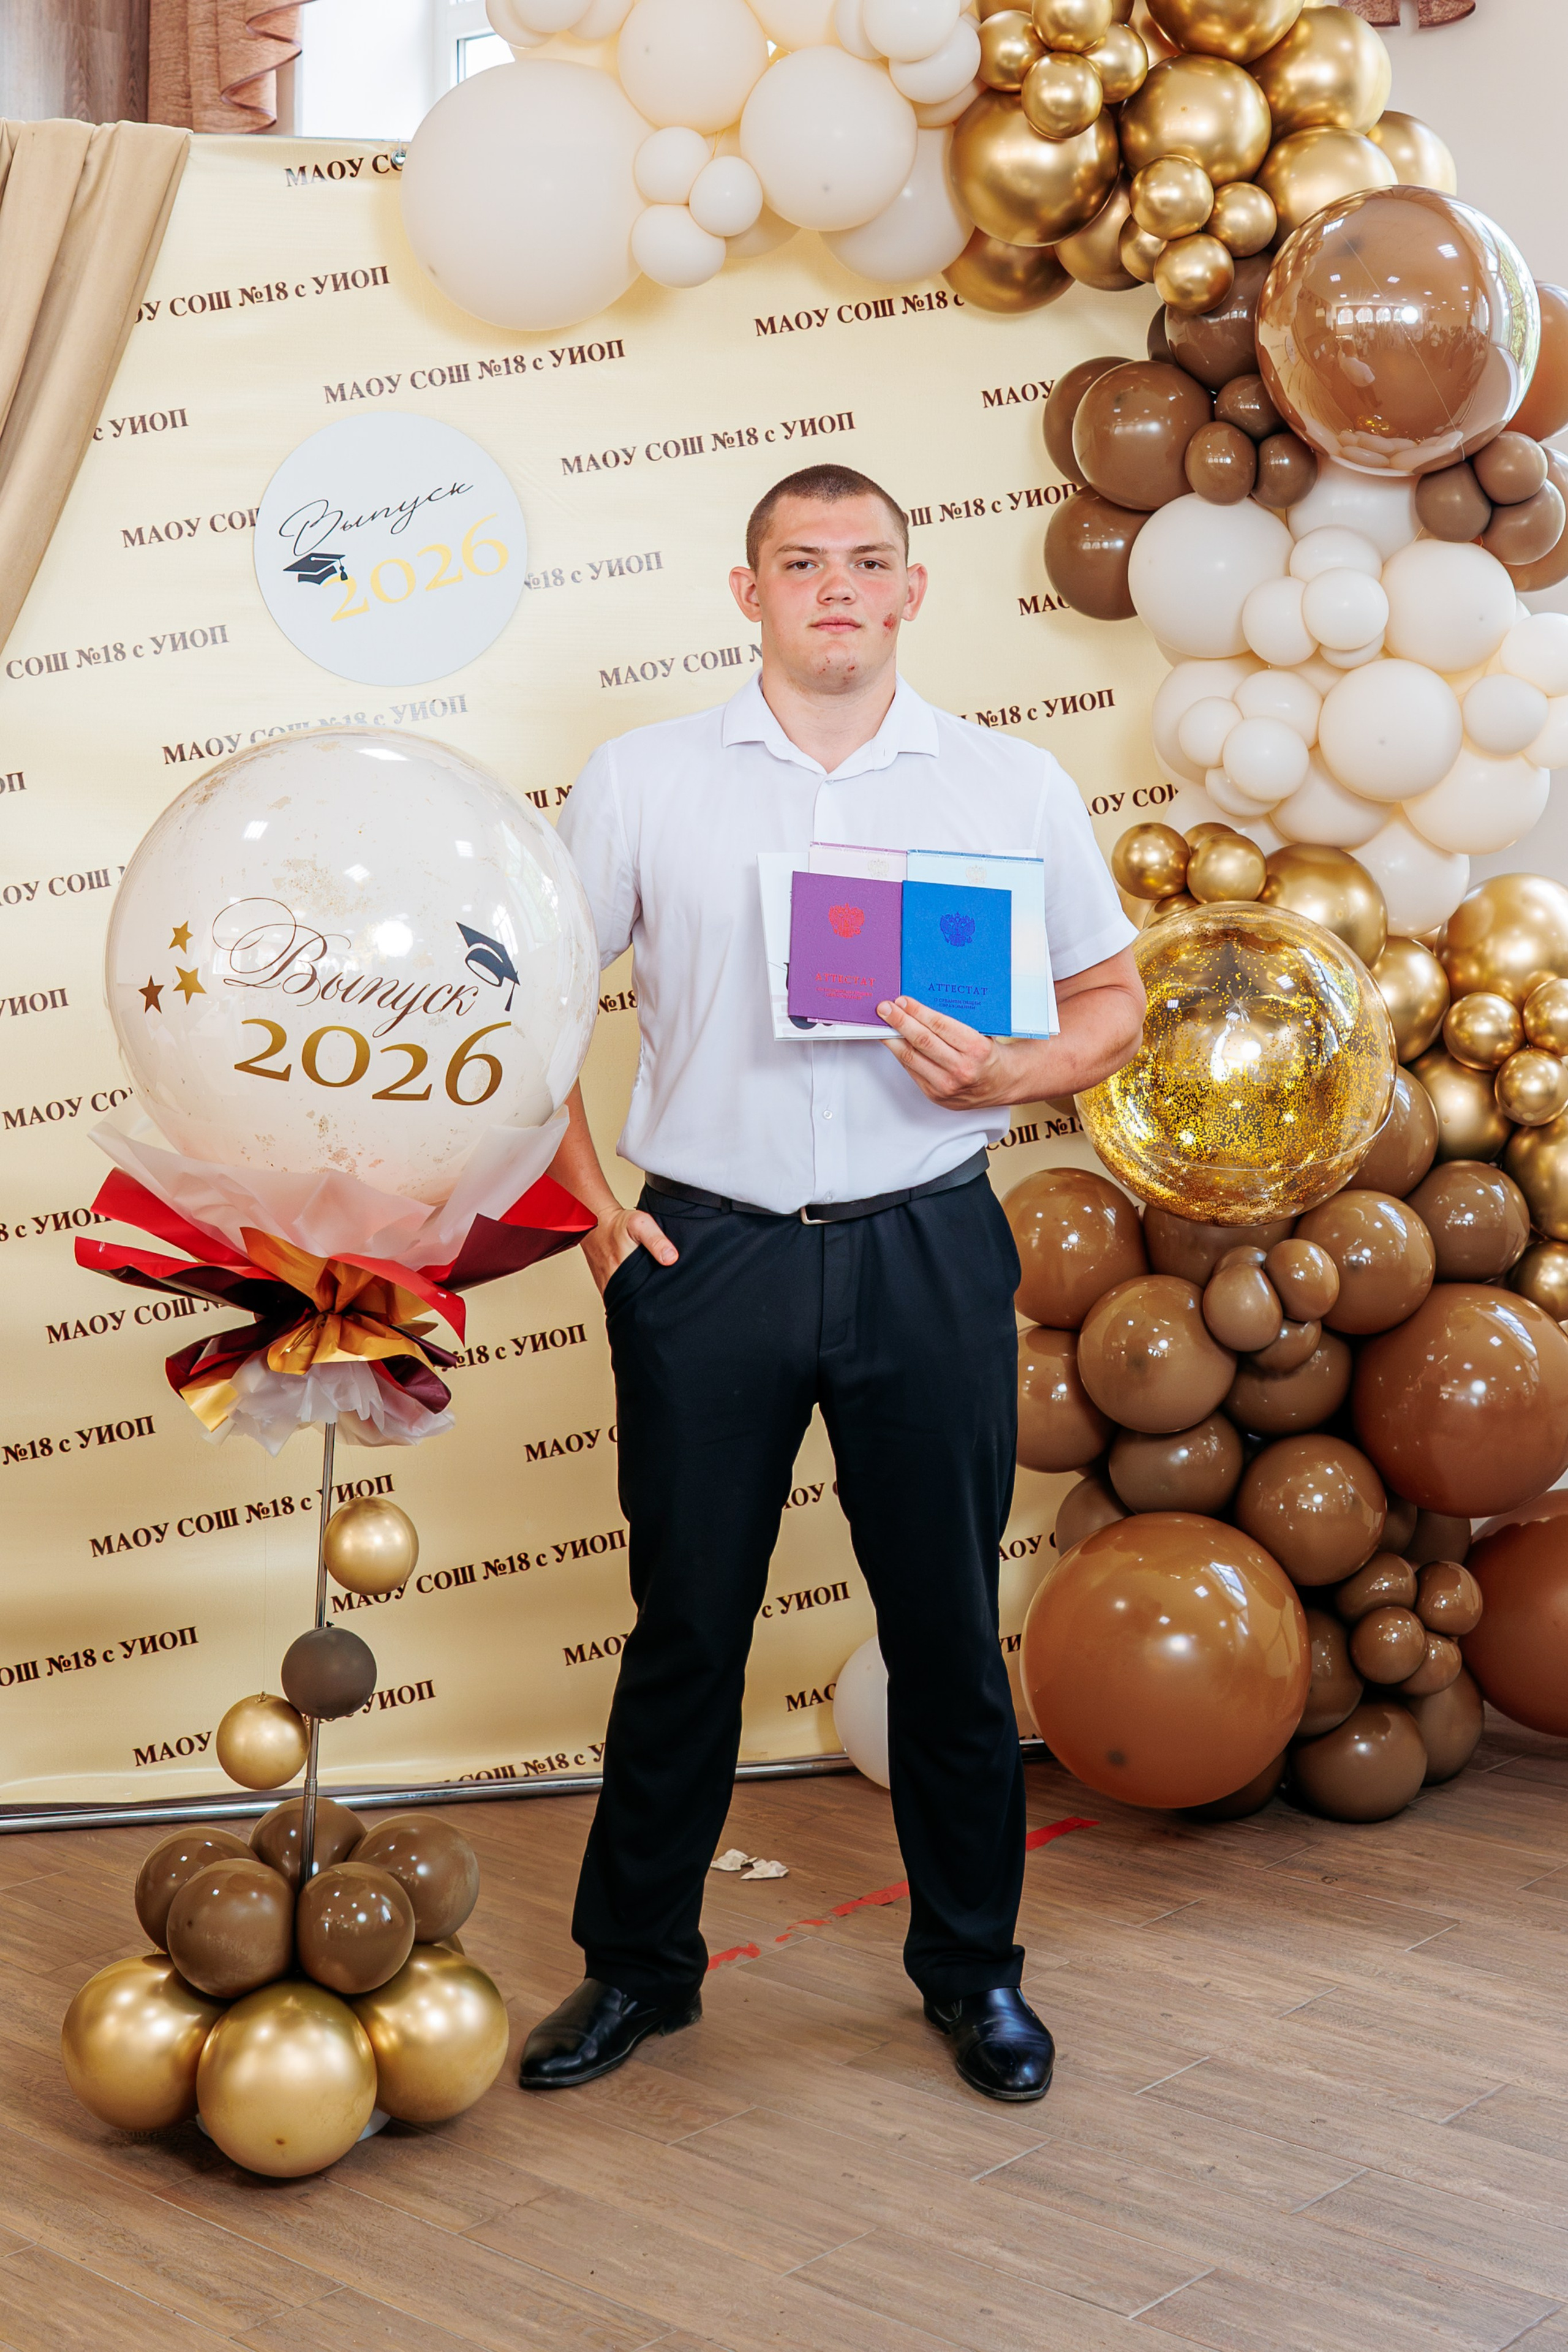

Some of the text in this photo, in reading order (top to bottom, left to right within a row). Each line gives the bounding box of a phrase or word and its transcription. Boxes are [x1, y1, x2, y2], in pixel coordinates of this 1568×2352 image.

[283, 157, 364, 187] МАОУ
[169, 290, 233, 317] СОШ
[238, 281, 289, 307] №18
[295, 282, 307, 298] с
[312, 265, 391, 295] УИОП
[754, 308, 829, 336] МАОУ
[837, 298, 895, 324] СОШ
[902, 290, 949, 315] №18
[323, 339, 626, 404] МАОУ СОШ №18 с УИОП
[981, 380, 1055, 408] МАОУ
[108, 408, 189, 439] УИОП
[560, 412, 856, 476] МАОУ СОШ №18 с УИОП
[279, 482, 473, 556] Выпуск
[939, 498, 986, 522] №18
[991, 500, 1002, 513] с
[121, 517, 202, 548] МАОУ
[322, 513, 508, 622] 2026
[571, 570, 581, 583] с
[587, 551, 663, 581] УИОП
[6, 625, 229, 679] СОШ №18 с УИОП
[599, 658, 676, 688] МАОУ
[683, 647, 742, 673] СОШ
[976, 688, 1116, 728] №18 с УИОП
[162, 733, 242, 764] МАОУ
[374, 714, 385, 726] с
[389, 694, 469, 724] УИОП
[48, 868, 111, 896] СОШ
[213, 897, 478, 1038] Выпуск
[815, 972, 876, 987] АТТЕСТАТ
[928, 982, 988, 995] АТТЕСТАТ
[233, 1017, 511, 1106] 2026
[2, 1097, 83, 1130] МАОУ
[16, 1224, 27, 1238] с
[46, 1297, 198, 1344] МАОУ СОШ
[495, 1346, 507, 1360] с
[510, 1324, 587, 1356] УИОП
[1, 1415, 156, 1464] №18 с УИОП
[524, 1429, 601, 1462] МАОУ
[784, 1482, 825, 1509] ОУ
[89, 1523, 170, 1558] МАОУ
[177, 1508, 240, 1537] СОШ
[246, 1496, 296, 1524] №18
[301, 1497, 312, 1510] с
[417, 1564, 478, 1594] СОШ
[481, 1553, 531, 1580] №18
[536, 1553, 548, 1567] с
[551, 1529, 627, 1563] УИОП
[761, 1581, 851, 1618] с УИОП
[47, 1648, 97, 1676] №18
[102, 1650, 115, 1662] с
[118, 1626, 198, 1659] УИОП
[562, 1632, 629, 1667] МАО
[132, 1731, 213, 1767] МАОУ
[521, 1753, 570, 1776] №18
[575, 1754, 586, 1765] с
